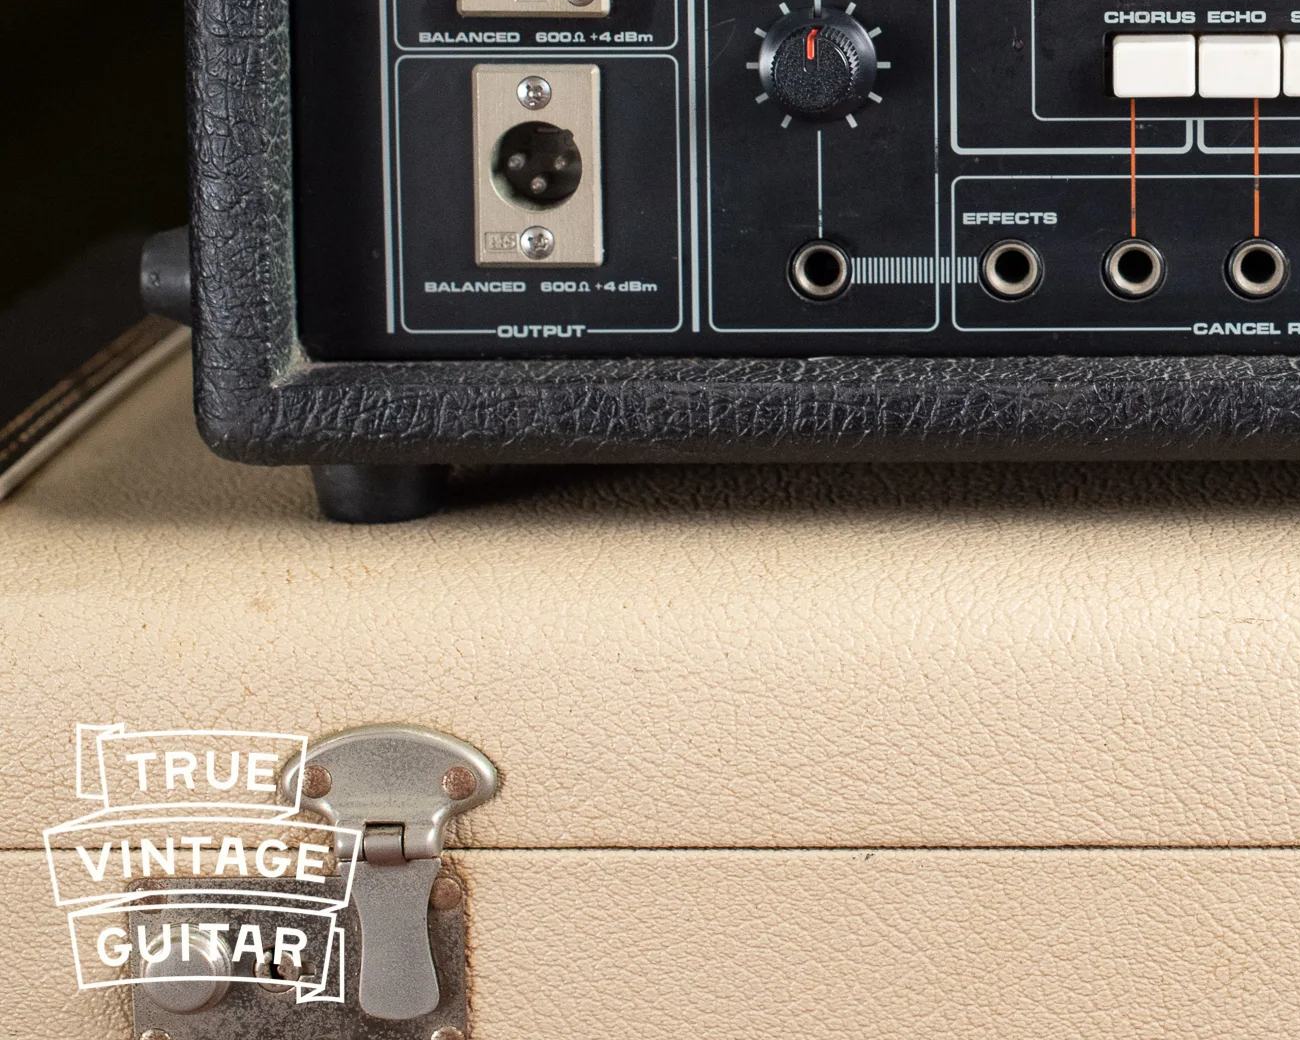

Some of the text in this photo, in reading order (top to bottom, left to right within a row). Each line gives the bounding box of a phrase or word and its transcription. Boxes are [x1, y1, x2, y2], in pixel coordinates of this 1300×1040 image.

[1104, 11, 1196, 23] CHORUS
[1207, 11, 1266, 23] ECHO
[419, 32, 520, 43] BALANCED
[614, 32, 653, 43] dBm
[962, 212, 1058, 225] EFFECTS
[424, 282, 526, 292] BALANCED
[618, 282, 657, 292] dBm
[497, 326, 586, 338] OUTPUT
[1193, 322, 1281, 335] CANCEL
